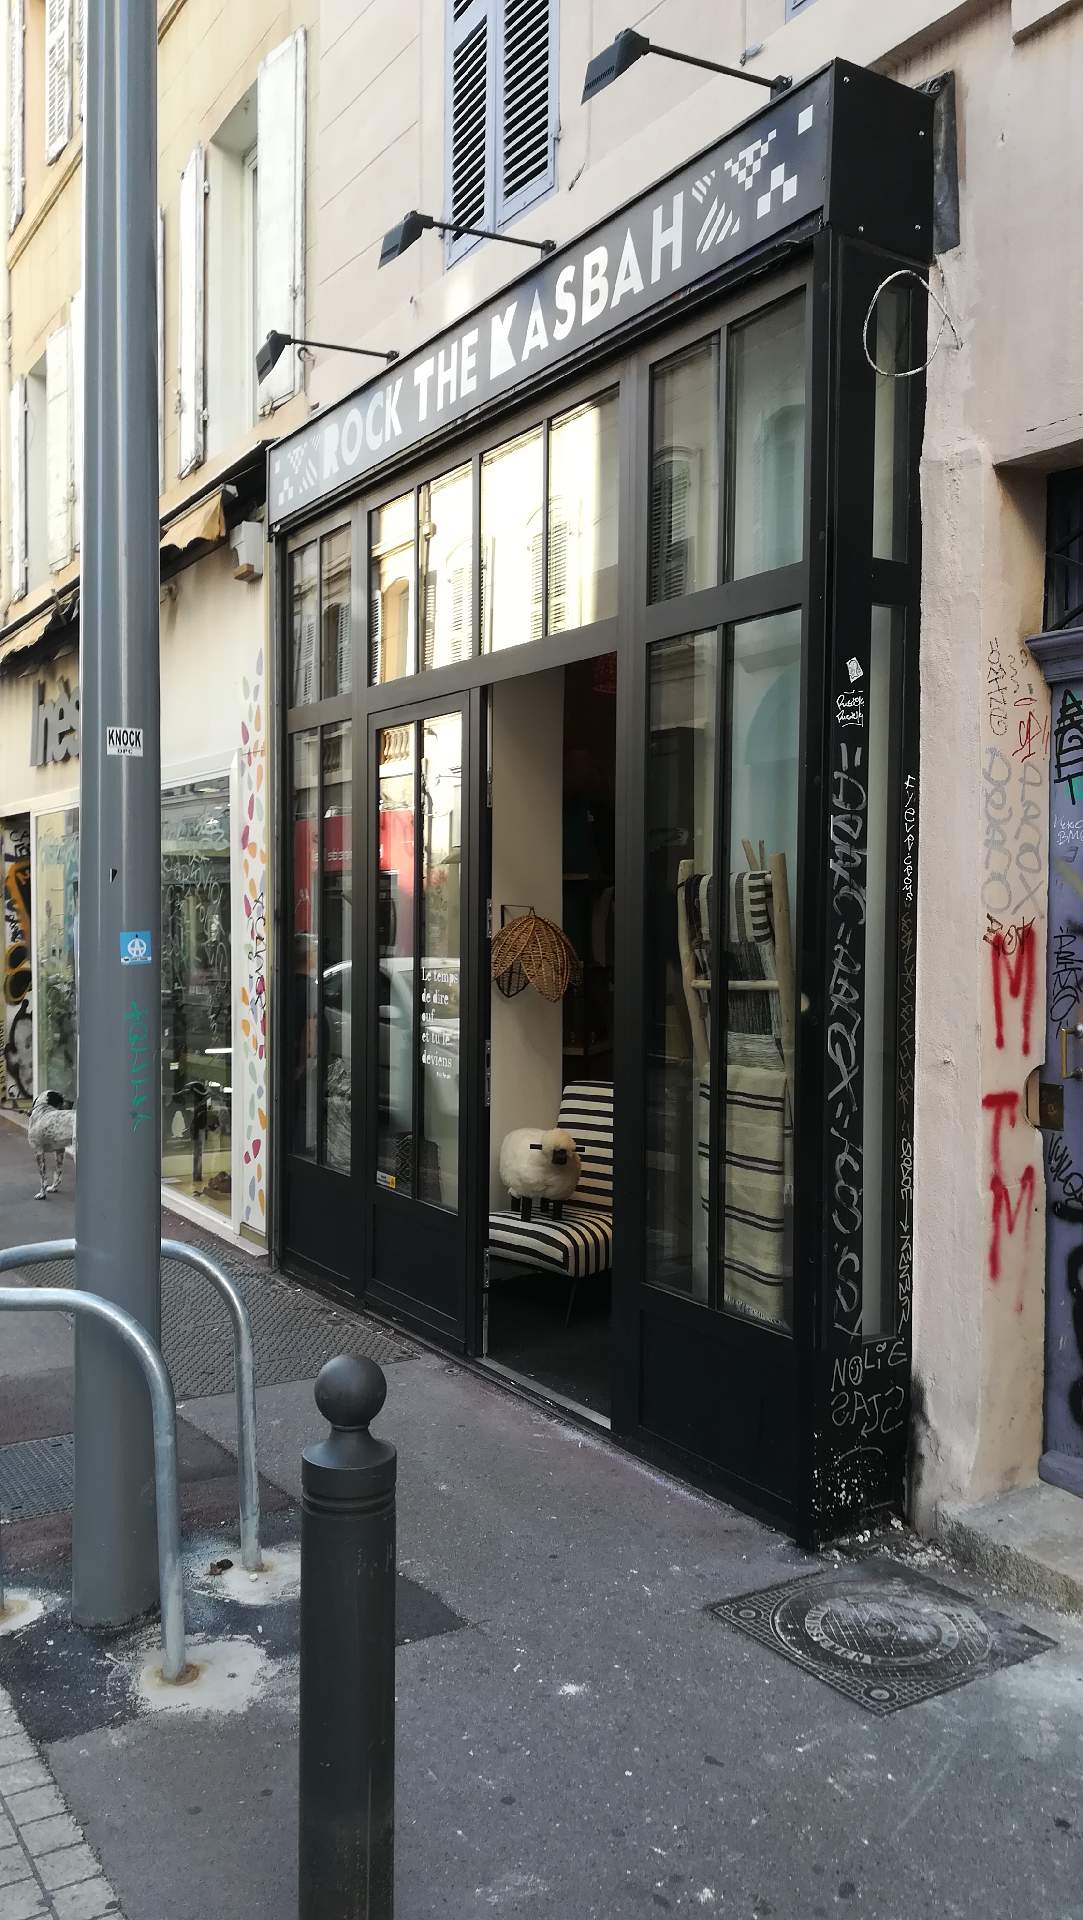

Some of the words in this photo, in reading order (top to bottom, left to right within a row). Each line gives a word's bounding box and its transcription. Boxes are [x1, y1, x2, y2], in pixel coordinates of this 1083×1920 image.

[322, 376, 403, 480] ROCK
[414, 328, 479, 422] THE
[490, 191, 684, 380] KASBAH
[108, 729, 141, 748] KNOCK
[422, 966, 432, 982] Le
[433, 969, 459, 987] temps
[421, 988, 431, 1003] de
[433, 989, 449, 1005] dire
[421, 1008, 436, 1022] ouf
[422, 1030, 430, 1043] et
[431, 1032, 440, 1045] tu
[421, 1049, 453, 1068] deviens
